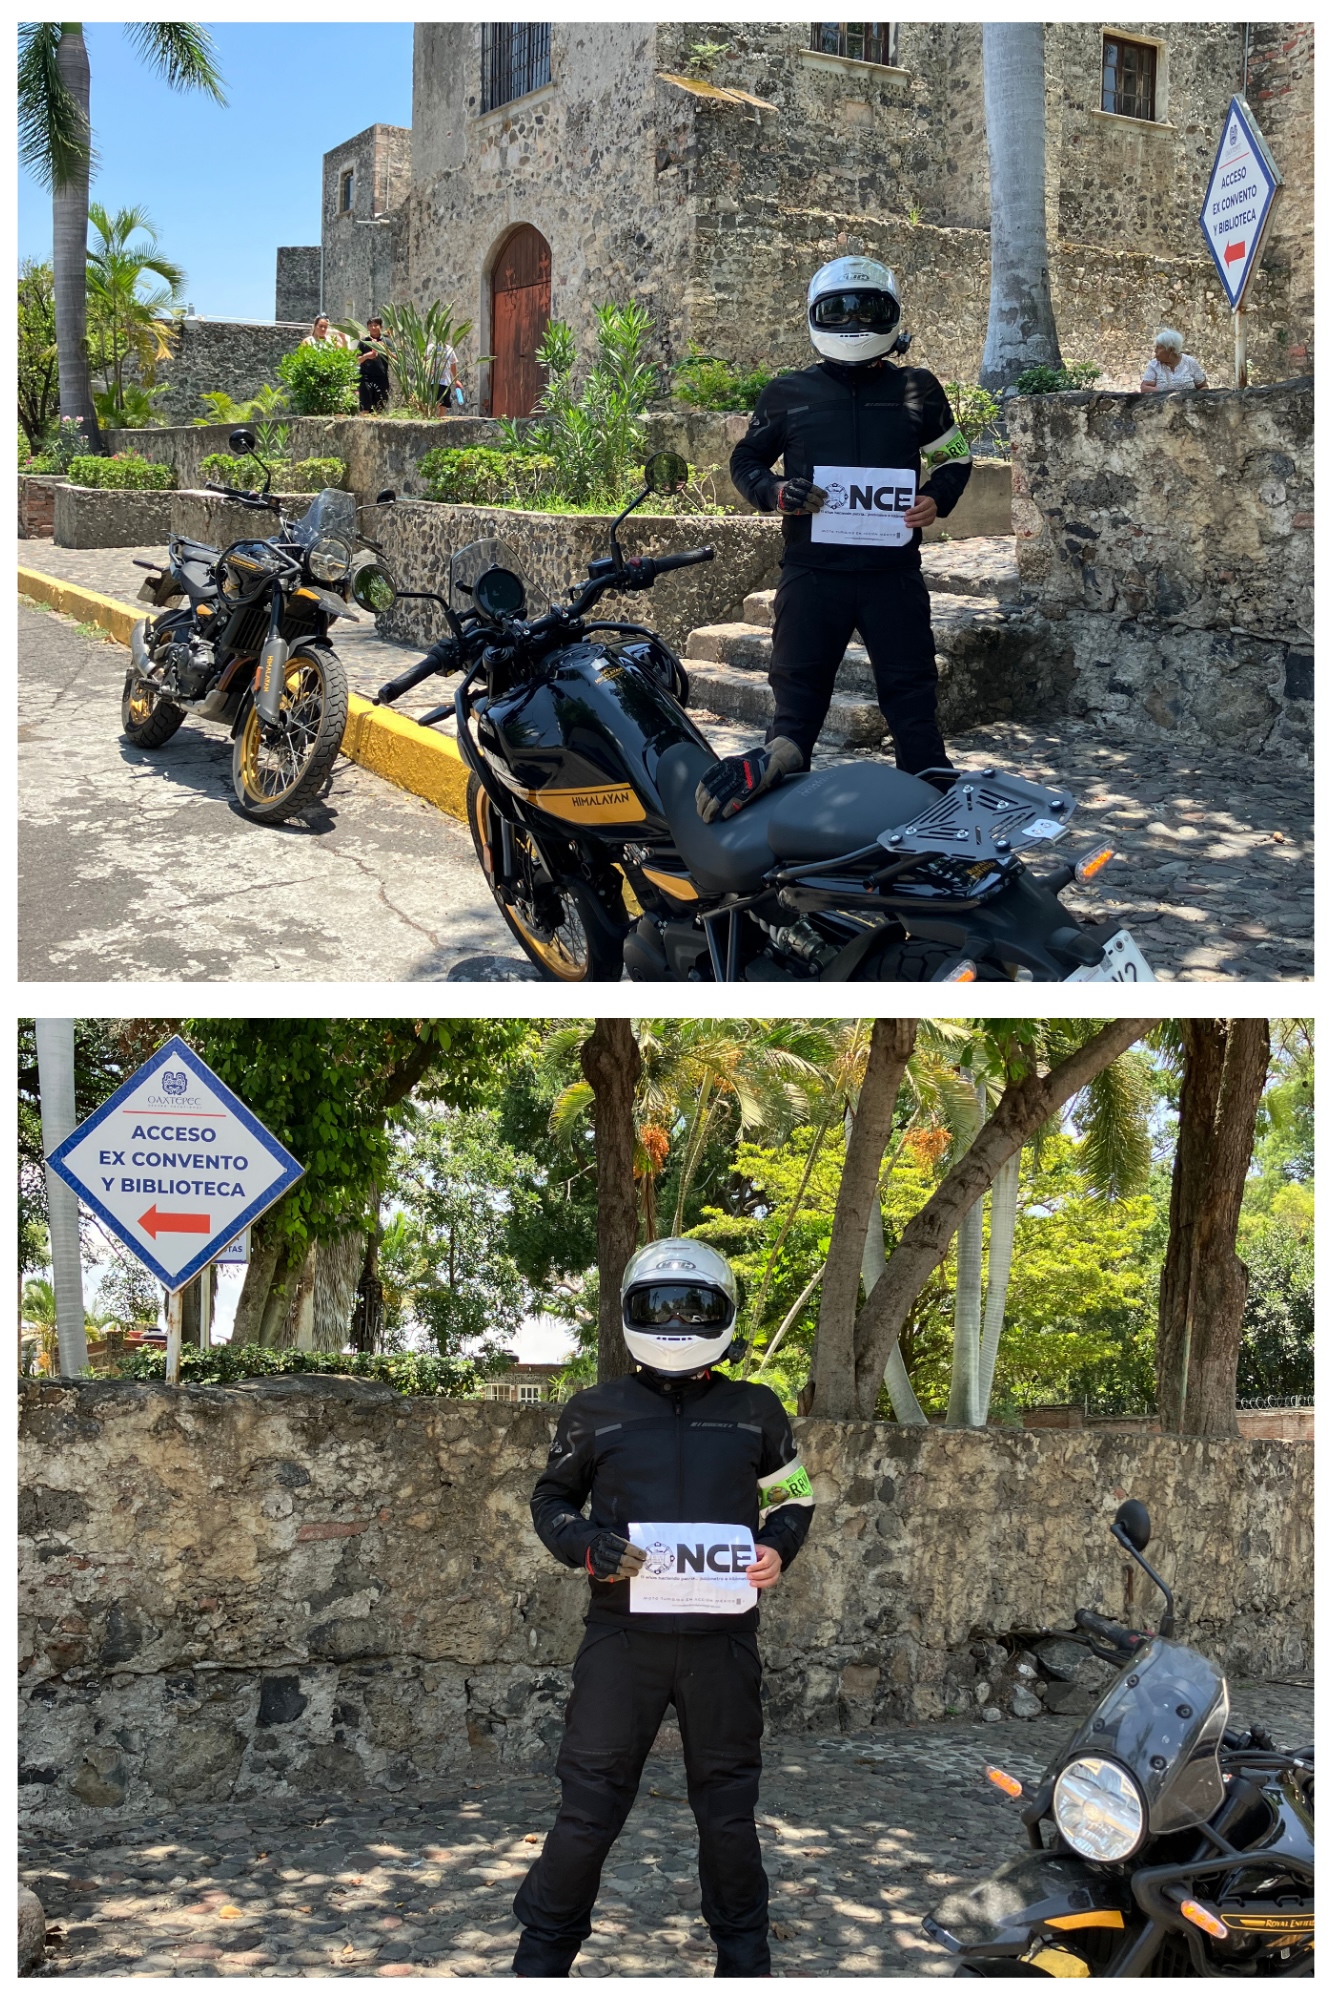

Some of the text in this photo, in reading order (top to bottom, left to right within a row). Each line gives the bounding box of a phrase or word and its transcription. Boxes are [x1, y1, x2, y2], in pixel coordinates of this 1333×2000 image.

[1221, 167, 1246, 189] ACCESO
[1213, 184, 1257, 215] EX CONVENTO
[1213, 208, 1256, 236] Y BIBLIOTECA
[849, 485, 913, 512] NCE
[264, 655, 274, 692] HIMALAYAN
[572, 792, 629, 807] HIMALAYAN
[147, 1095, 202, 1106] OAXTEPEC
[131, 1125, 216, 1142] ACCESO
[99, 1150, 248, 1171] EX CONVENTO
[101, 1177, 246, 1197] Y BIBLIOTECA
[225, 1245, 243, 1253] TAS
[676, 1543, 752, 1573] NCE
[1265, 1919, 1289, 1927] ROYAL
